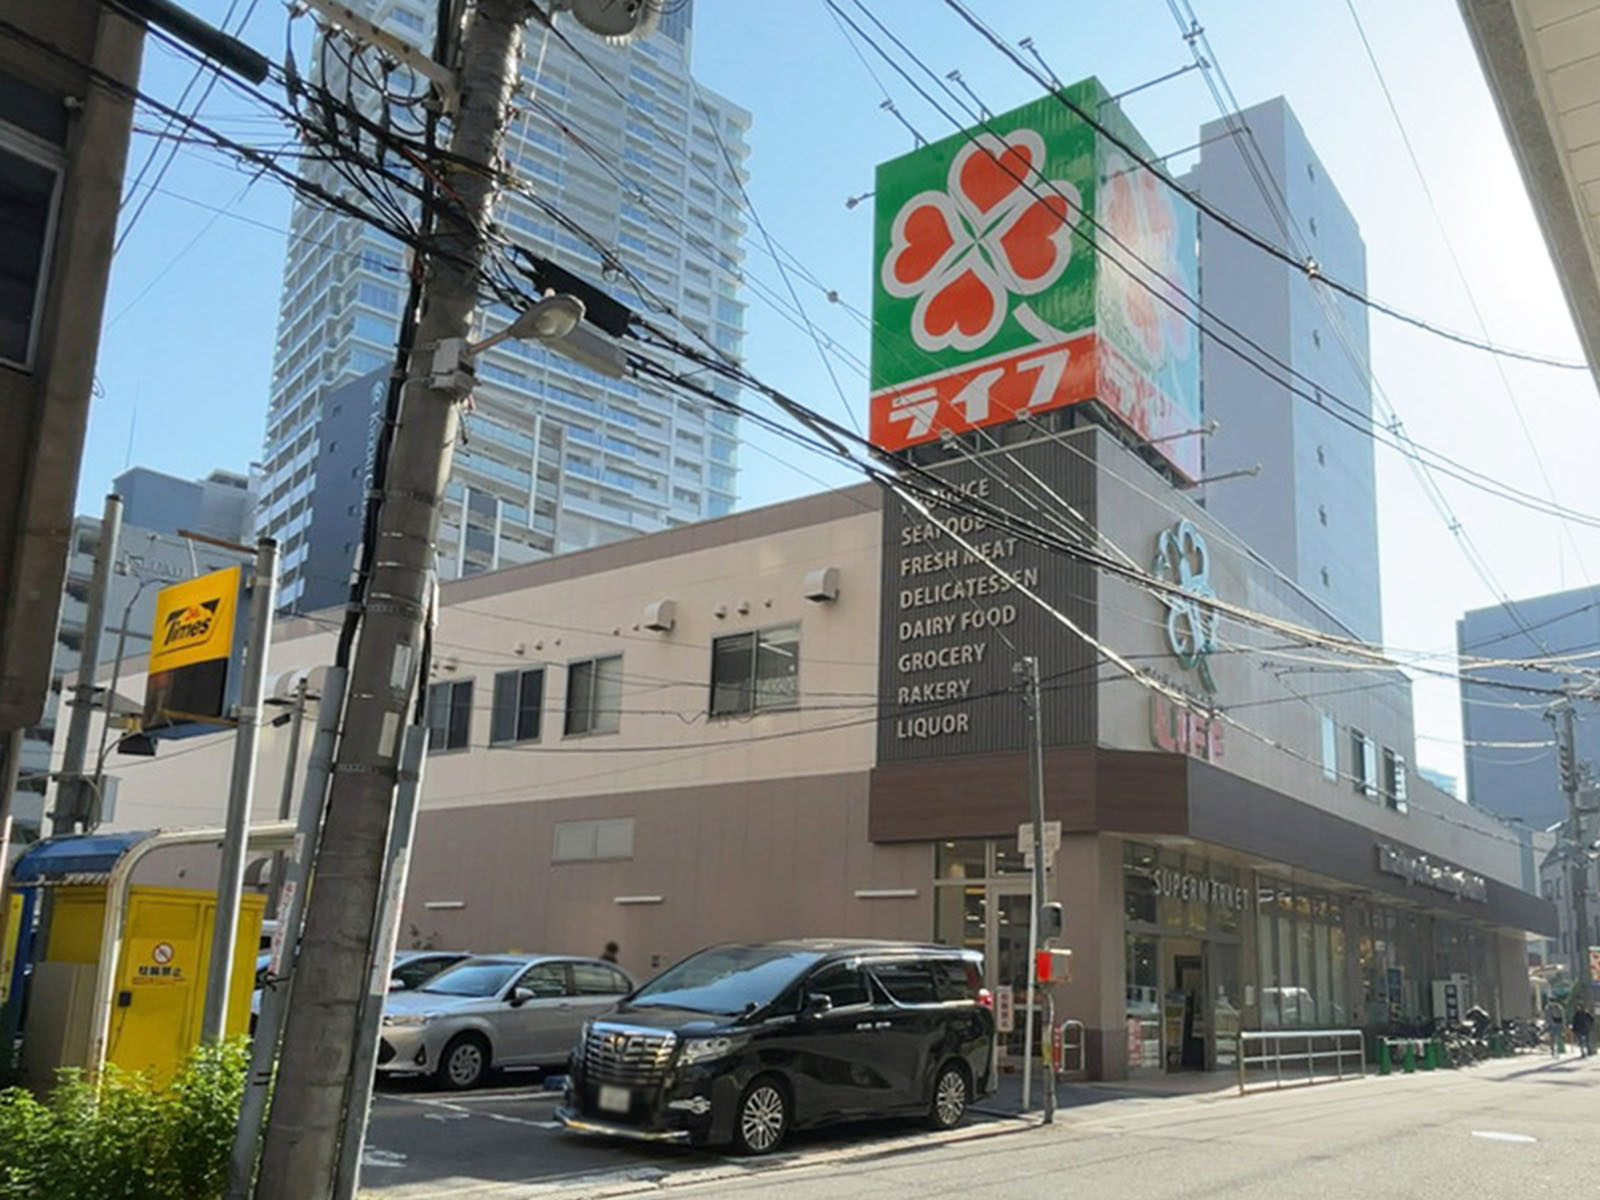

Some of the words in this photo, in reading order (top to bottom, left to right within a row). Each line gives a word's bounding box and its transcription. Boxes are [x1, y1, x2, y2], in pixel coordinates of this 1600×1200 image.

[888, 348, 1070, 440] ライフ
[901, 550, 958, 576] FRESH
[963, 537, 1018, 565] MEAT
[164, 599, 219, 646] Times
[900, 614, 956, 640] DAIRY
[960, 604, 1016, 631] FOOD
[898, 643, 986, 673] GROCERY
[897, 713, 969, 739] LIQUOR
[1150, 697, 1224, 764] LIFE
[1153, 868, 1249, 910] SUPERMARKET
